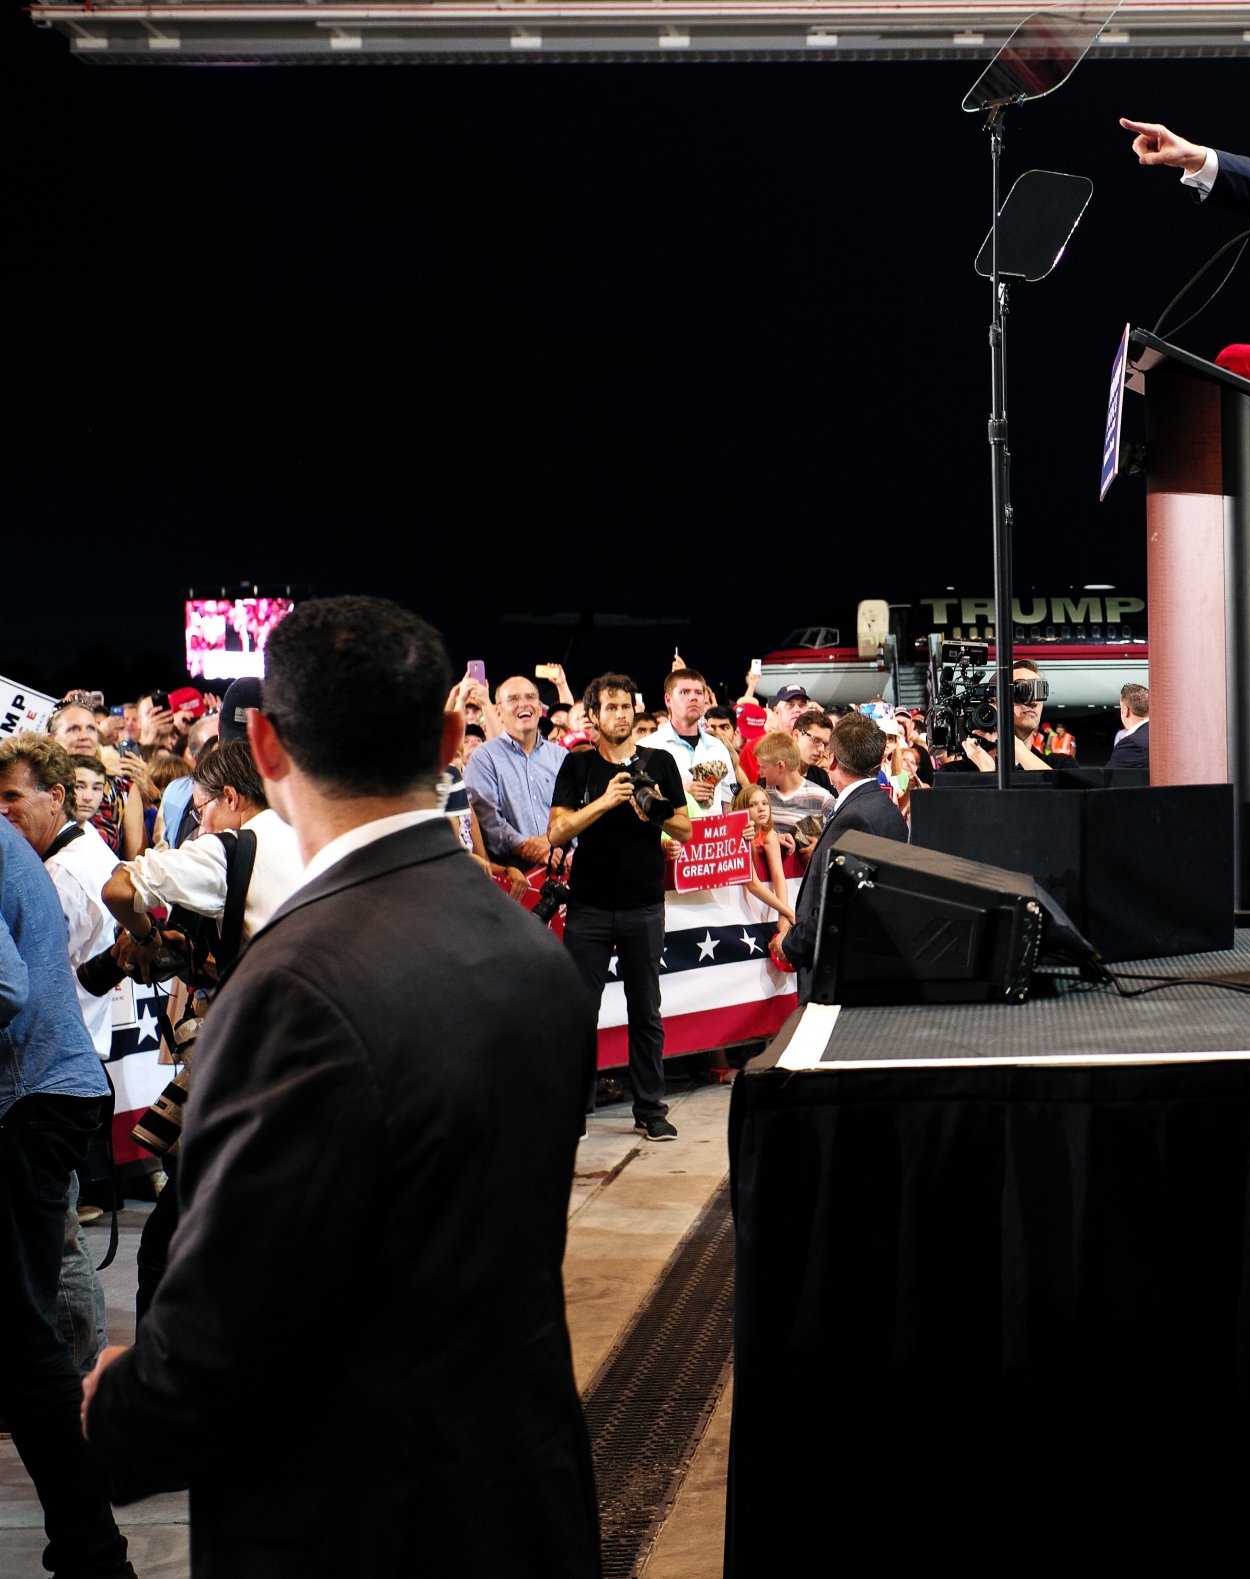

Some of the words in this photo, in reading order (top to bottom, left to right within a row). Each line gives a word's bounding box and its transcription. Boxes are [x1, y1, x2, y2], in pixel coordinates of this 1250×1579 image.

[920, 597, 1145, 624] TRUMP
[0, 694, 25, 740] MP
[704, 825, 727, 839] MAKE
[678, 837, 749, 863] AMERICA
[682, 862, 716, 878] GREAT
[717, 857, 744, 874] AGAIN
